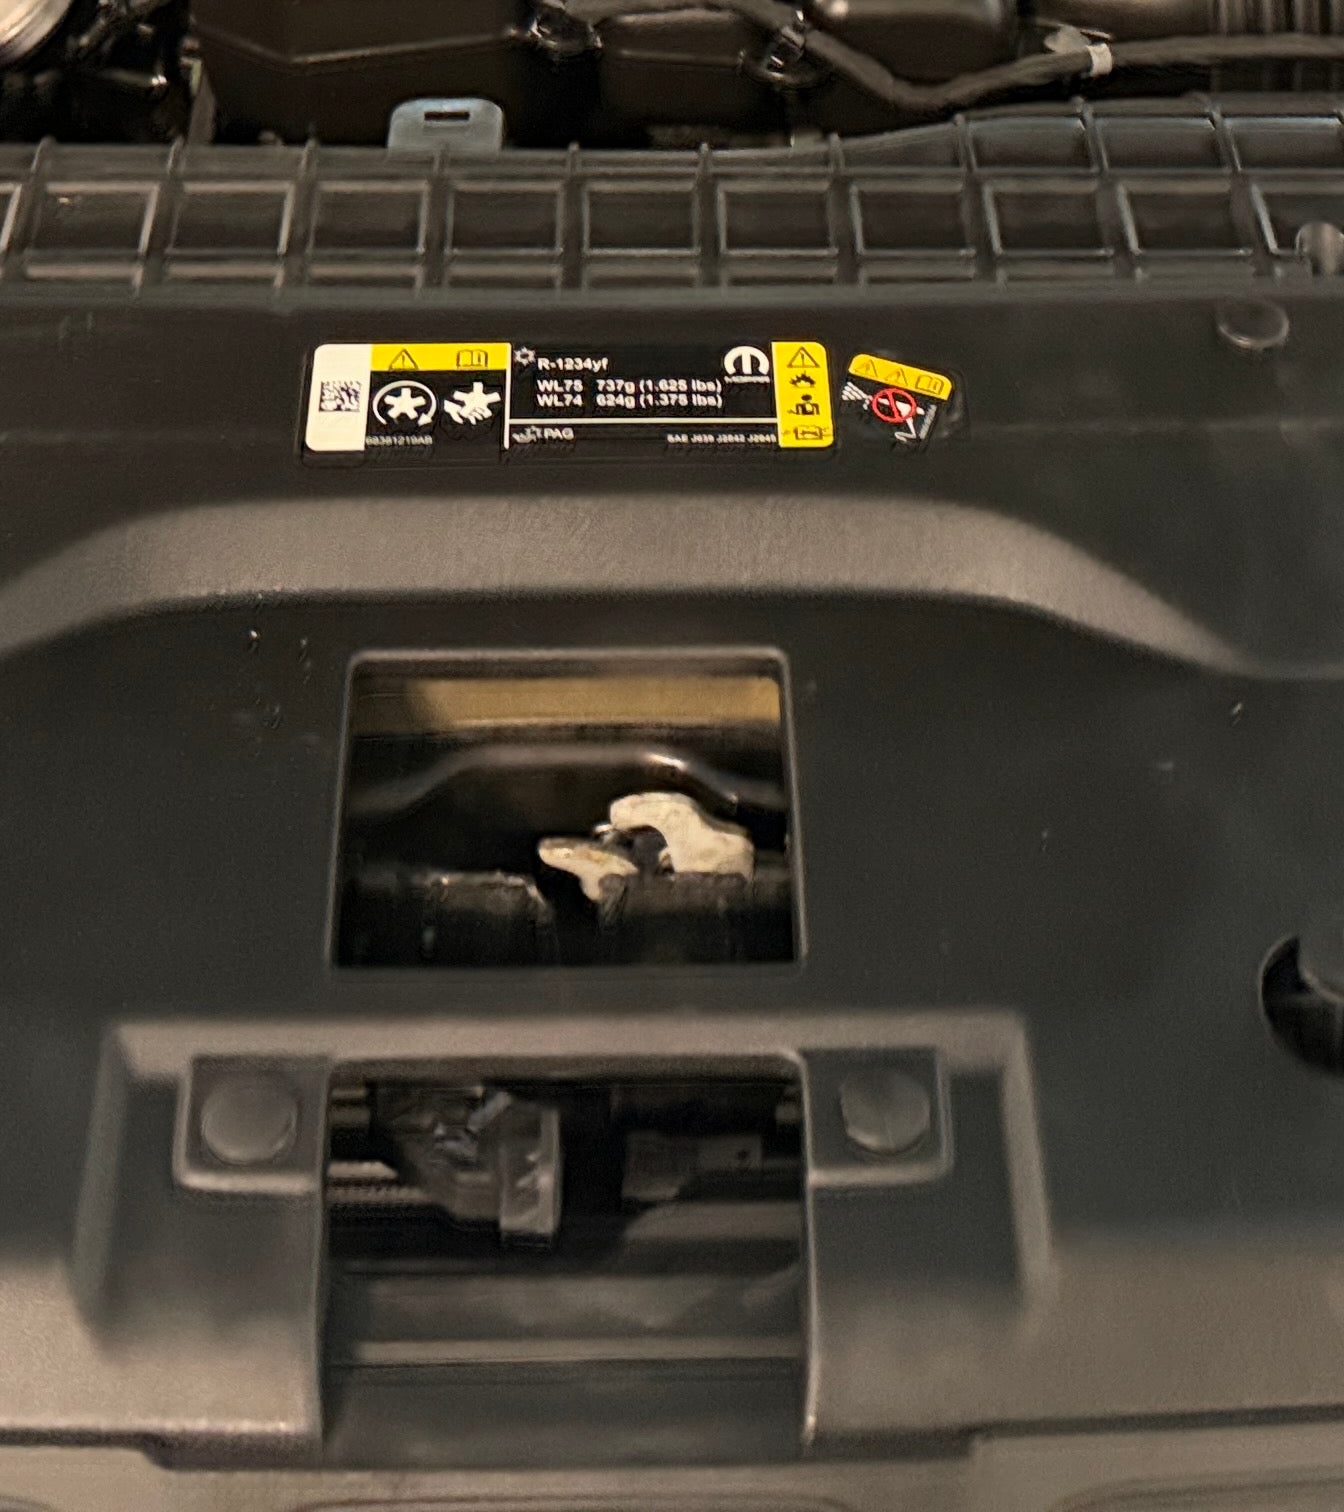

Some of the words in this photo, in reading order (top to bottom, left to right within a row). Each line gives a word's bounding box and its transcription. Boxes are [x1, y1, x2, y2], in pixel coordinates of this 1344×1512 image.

[537, 357, 609, 373] R-1234yf
[596, 379, 636, 395] 737g
[691, 378, 722, 394] lbs)
[536, 393, 584, 407] WL74
[691, 392, 723, 409] lbs)
